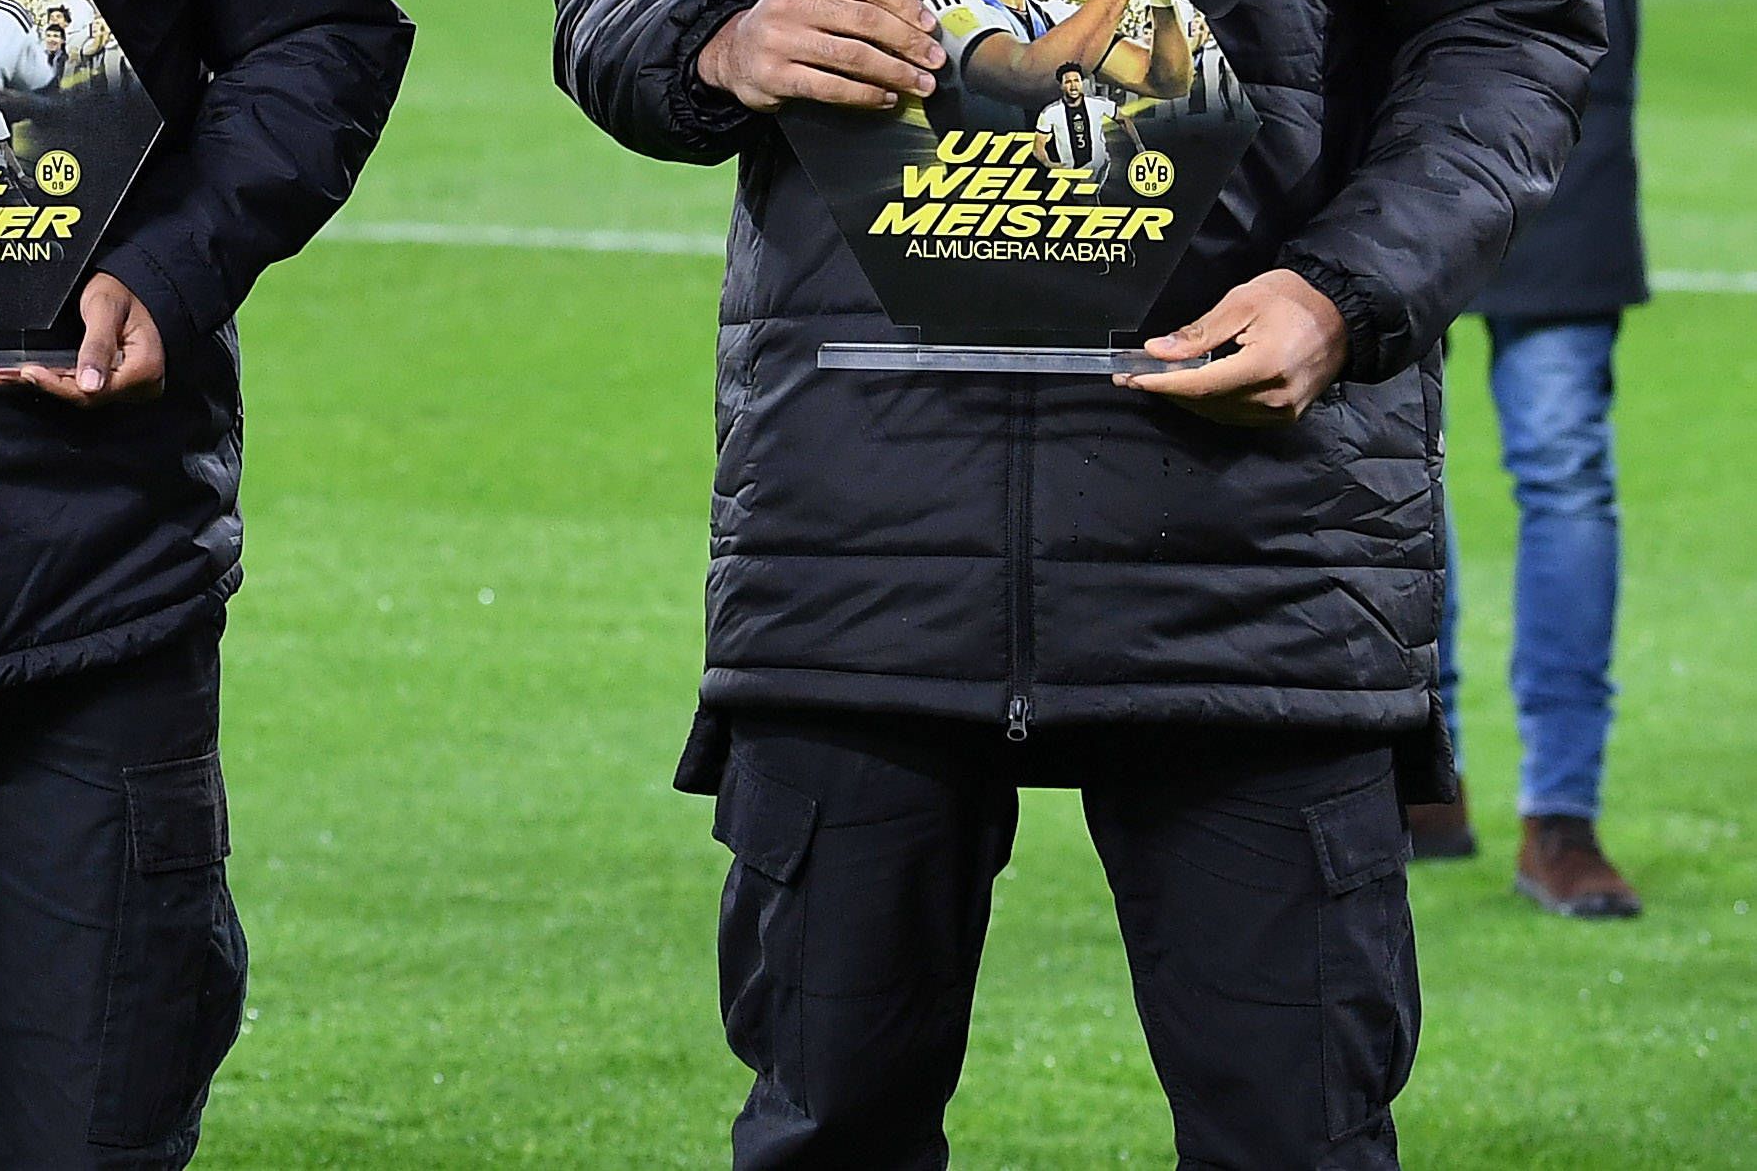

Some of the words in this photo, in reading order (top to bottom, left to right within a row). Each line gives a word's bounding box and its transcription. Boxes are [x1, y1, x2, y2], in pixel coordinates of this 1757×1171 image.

[936, 130, 1053, 165] U17
[42, 156, 75, 181] BVB
[903, 165, 1100, 201] WELT-
[1135, 156, 1169, 183] BVB
[867, 202, 1174, 241] MEISTER
[905, 239, 1040, 262] ALMUGERA
[1044, 242, 1126, 263] KABAR
